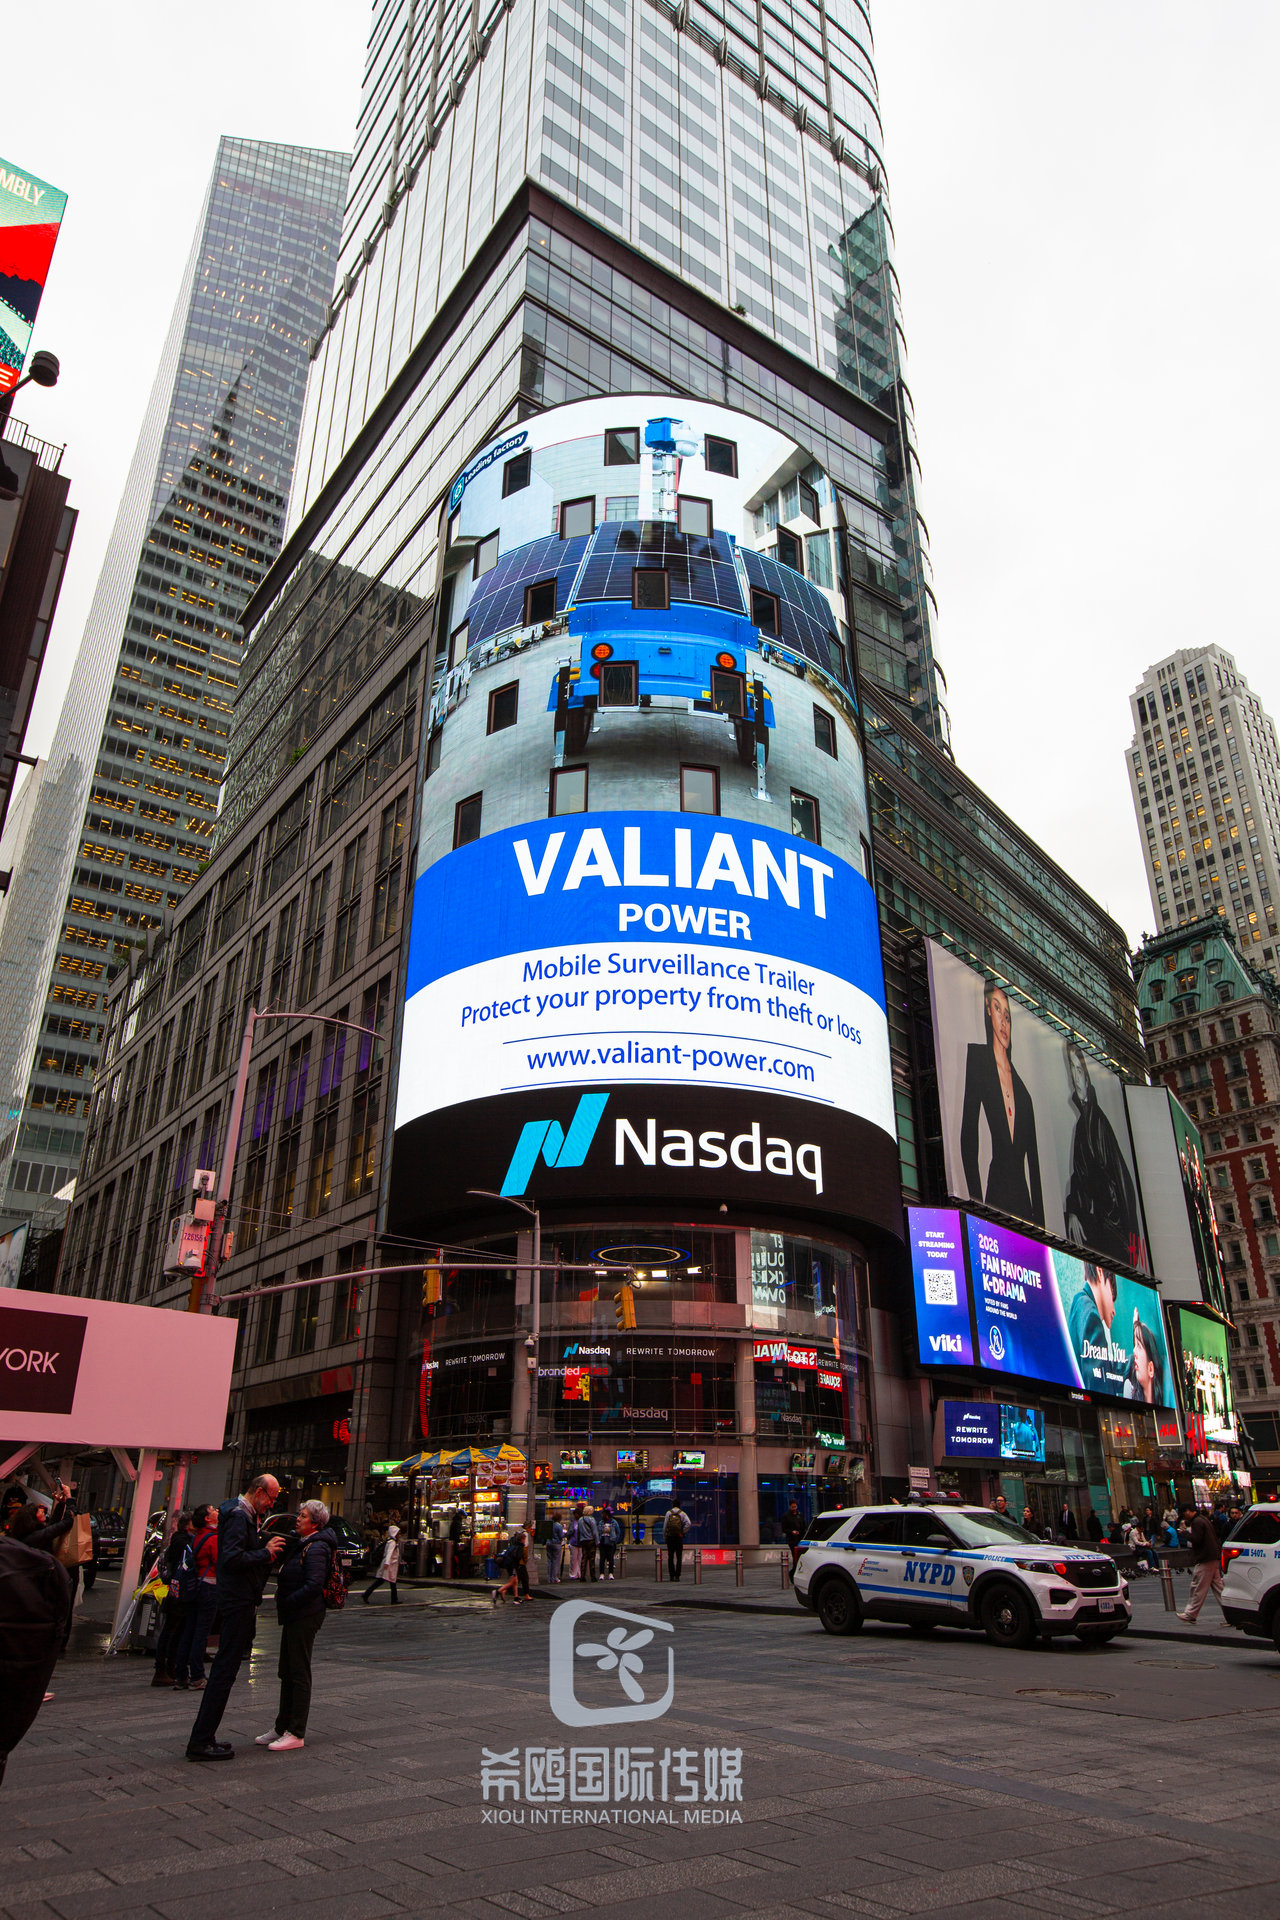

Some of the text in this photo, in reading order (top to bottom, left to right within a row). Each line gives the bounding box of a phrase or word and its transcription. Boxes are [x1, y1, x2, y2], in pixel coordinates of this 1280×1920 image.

[465, 434, 525, 484] Leading factory
[513, 826, 834, 919] VALIANT
[618, 903, 752, 941] POWER
[523, 952, 815, 996] Mobile Surveillance Trailer
[461, 986, 862, 1045] Protect your property from theft or loss
[527, 1040, 815, 1082] www.valiant-power.com
[614, 1118, 824, 1195] Nasdaq
[918, 1240, 955, 1249] STREAMING
[978, 1233, 999, 1254] 2026
[980, 1252, 1042, 1290] FAN FAVORITE
[982, 1273, 1027, 1303] K-DRAMA
[578, 1346, 715, 1356] Nasdaq REWRITE TOMORROW
[929, 1334, 962, 1352] Viki
[1080, 1339, 1108, 1361] Dream
[1112, 1342, 1128, 1364] You
[445, 1356, 467, 1366] REWRITE
[469, 1352, 506, 1363] TOMORROW
[818, 1359, 839, 1369] REWRITE
[623, 1407, 669, 1421] Nasdaq
[951, 1436, 994, 1444] TOMORROW
[956, 1426, 988, 1434] REWRITE
[984, 1554, 1006, 1562] POLICE
[904, 1560, 956, 1586] NYPD
